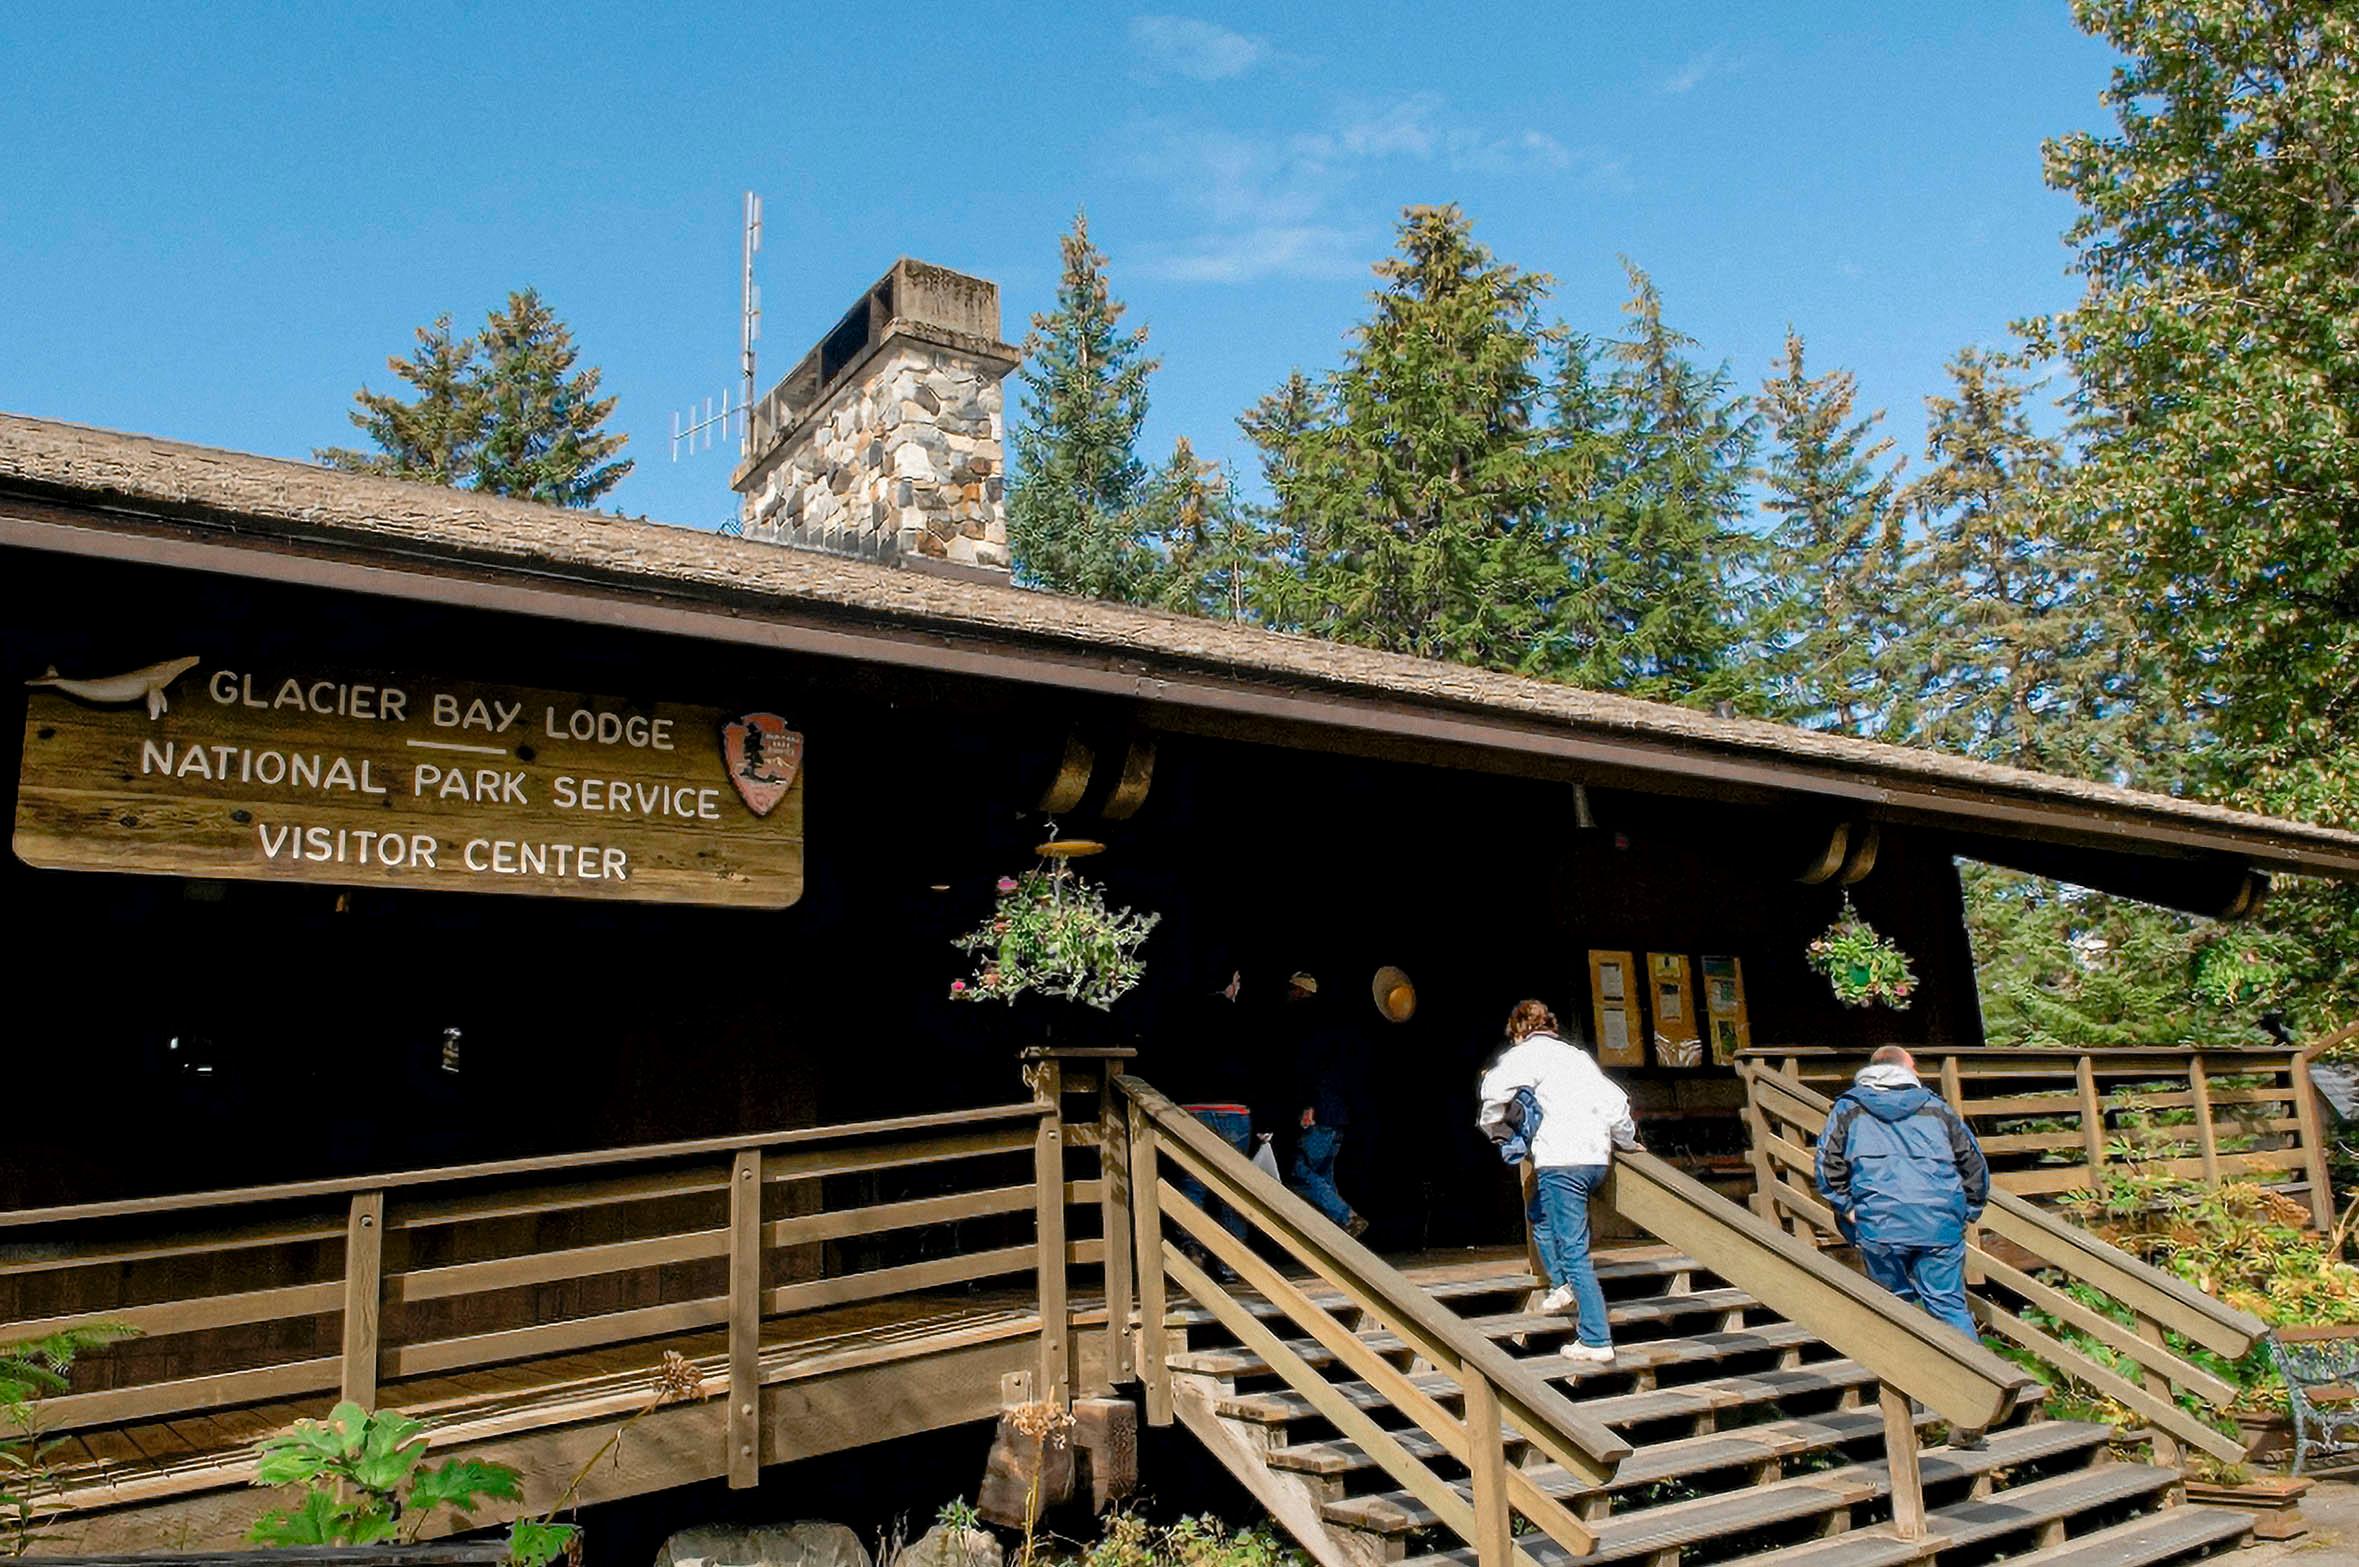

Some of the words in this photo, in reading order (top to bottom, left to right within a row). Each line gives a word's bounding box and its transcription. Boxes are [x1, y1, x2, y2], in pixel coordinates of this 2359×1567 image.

[210, 671, 406, 721] GLACIER
[433, 695, 521, 732] BAY
[546, 707, 674, 750] LODGE
[143, 741, 386, 793] NATIONAL
[414, 764, 528, 805] PARK
[554, 778, 720, 819] SERVICE
[259, 825, 437, 868] VISITOR
[464, 840, 627, 880] CENTER
